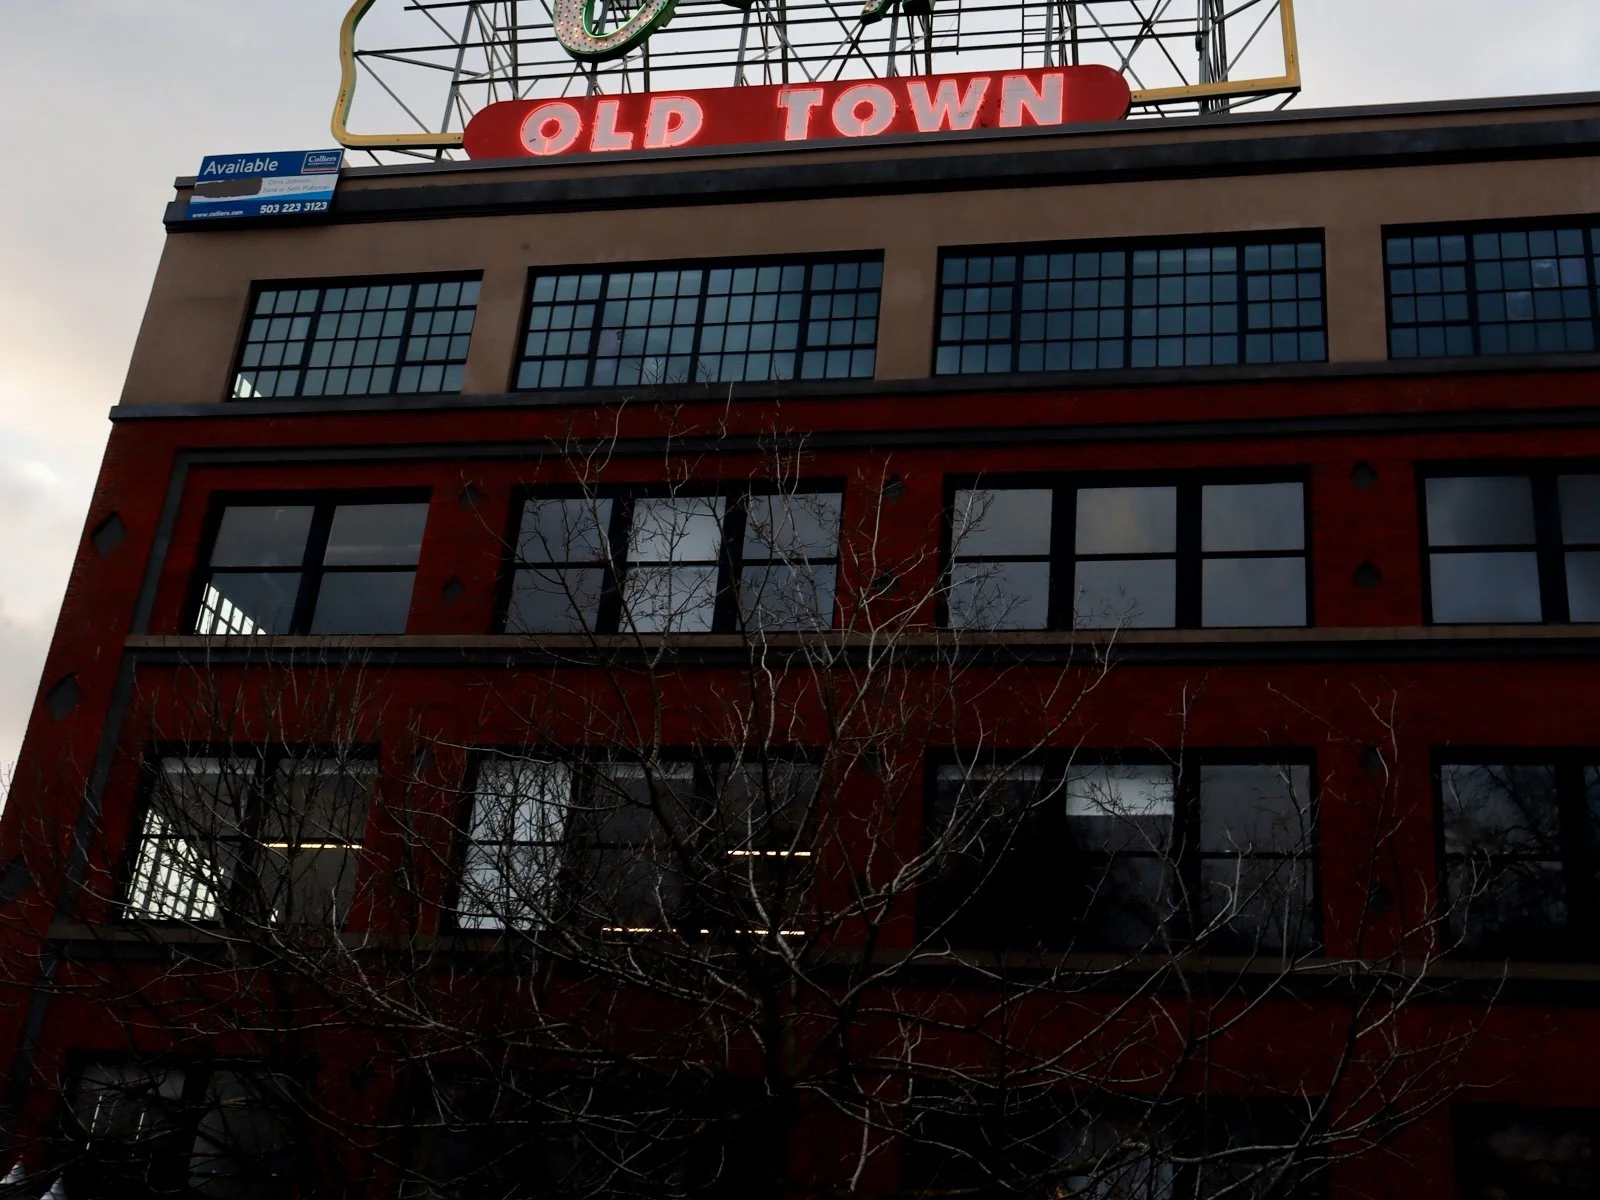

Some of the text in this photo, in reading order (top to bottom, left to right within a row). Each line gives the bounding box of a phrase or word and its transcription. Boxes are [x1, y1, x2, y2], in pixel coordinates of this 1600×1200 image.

[519, 72, 1066, 157] OLD TOWN
[308, 155, 337, 163] Colliers
[203, 158, 279, 175] Available
[259, 201, 328, 214] 503 223 3123
[192, 210, 244, 219] www.colliers.com
